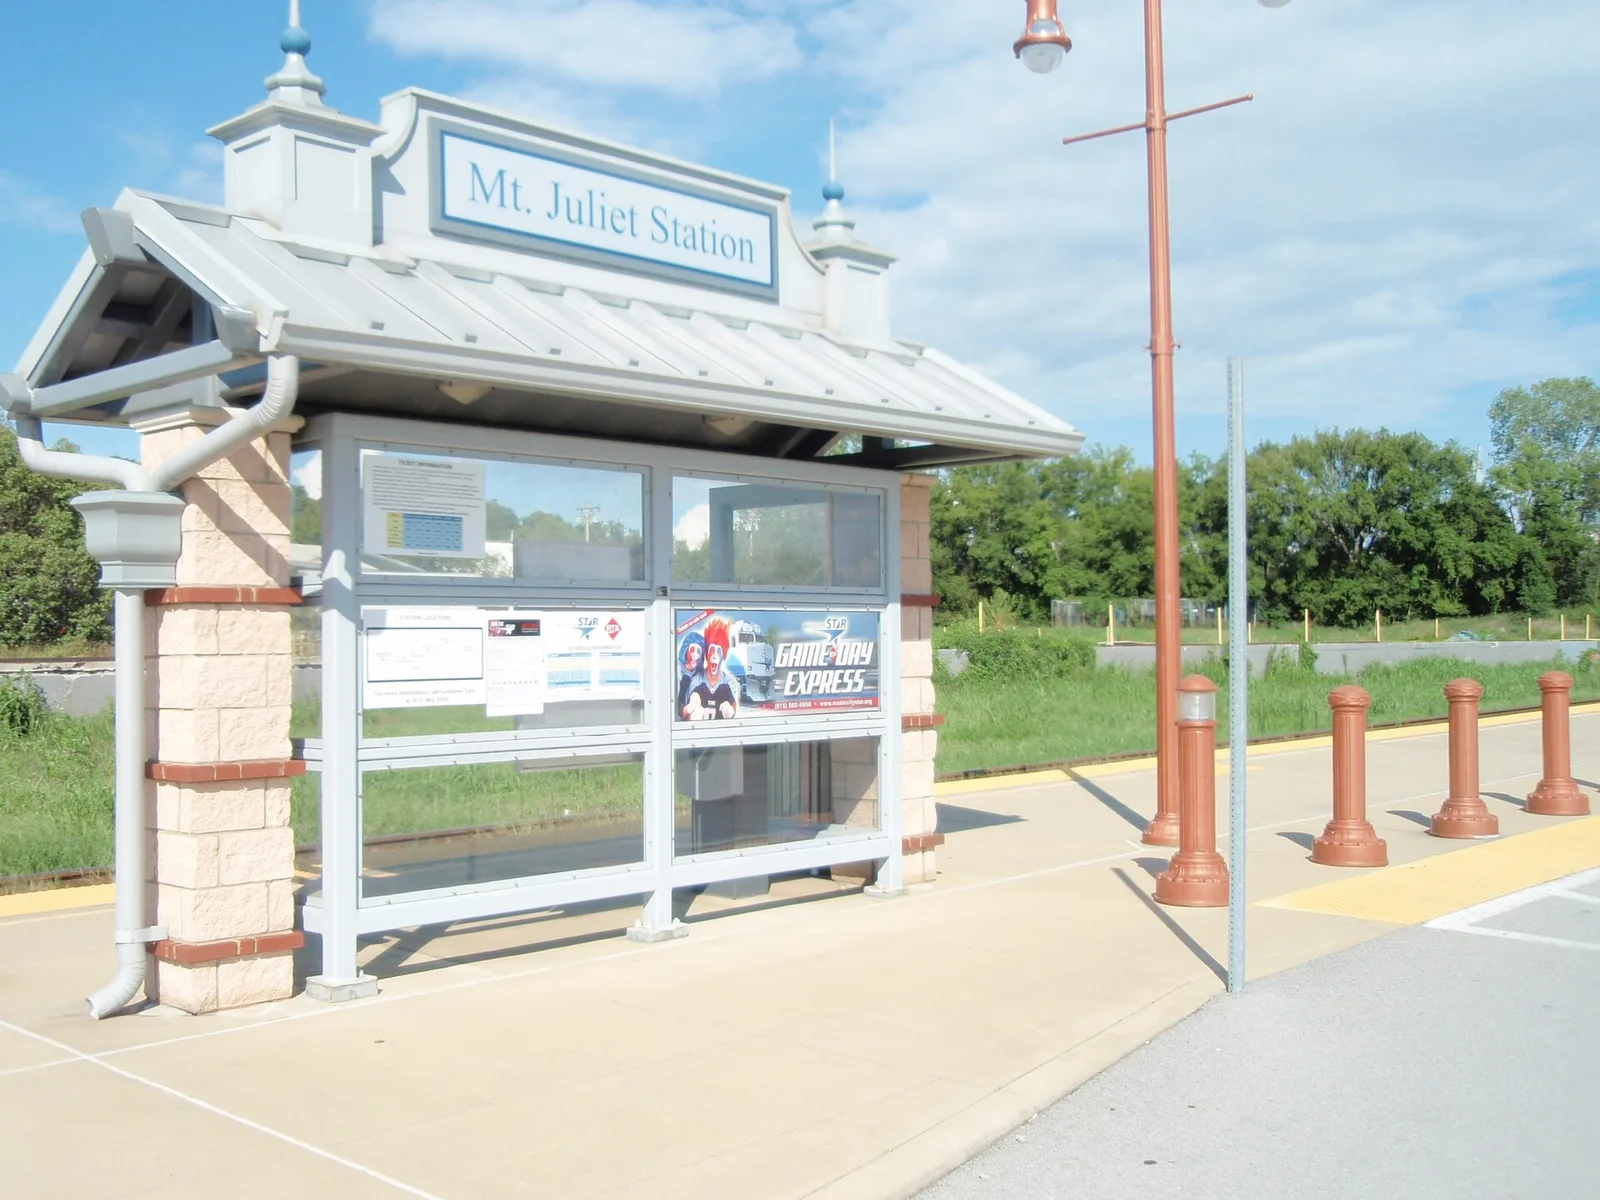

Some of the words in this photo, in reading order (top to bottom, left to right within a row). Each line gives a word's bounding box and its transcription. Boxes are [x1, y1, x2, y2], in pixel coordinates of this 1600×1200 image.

[468, 161, 531, 214] Mt.
[547, 181, 638, 238] Juliet
[651, 206, 755, 264] Station
[826, 618, 847, 629] STAR
[775, 642, 831, 668] GAME
[835, 641, 874, 666] DAY
[783, 669, 866, 696] EXPRESS
[820, 699, 873, 707] www.musiccitystar.org
